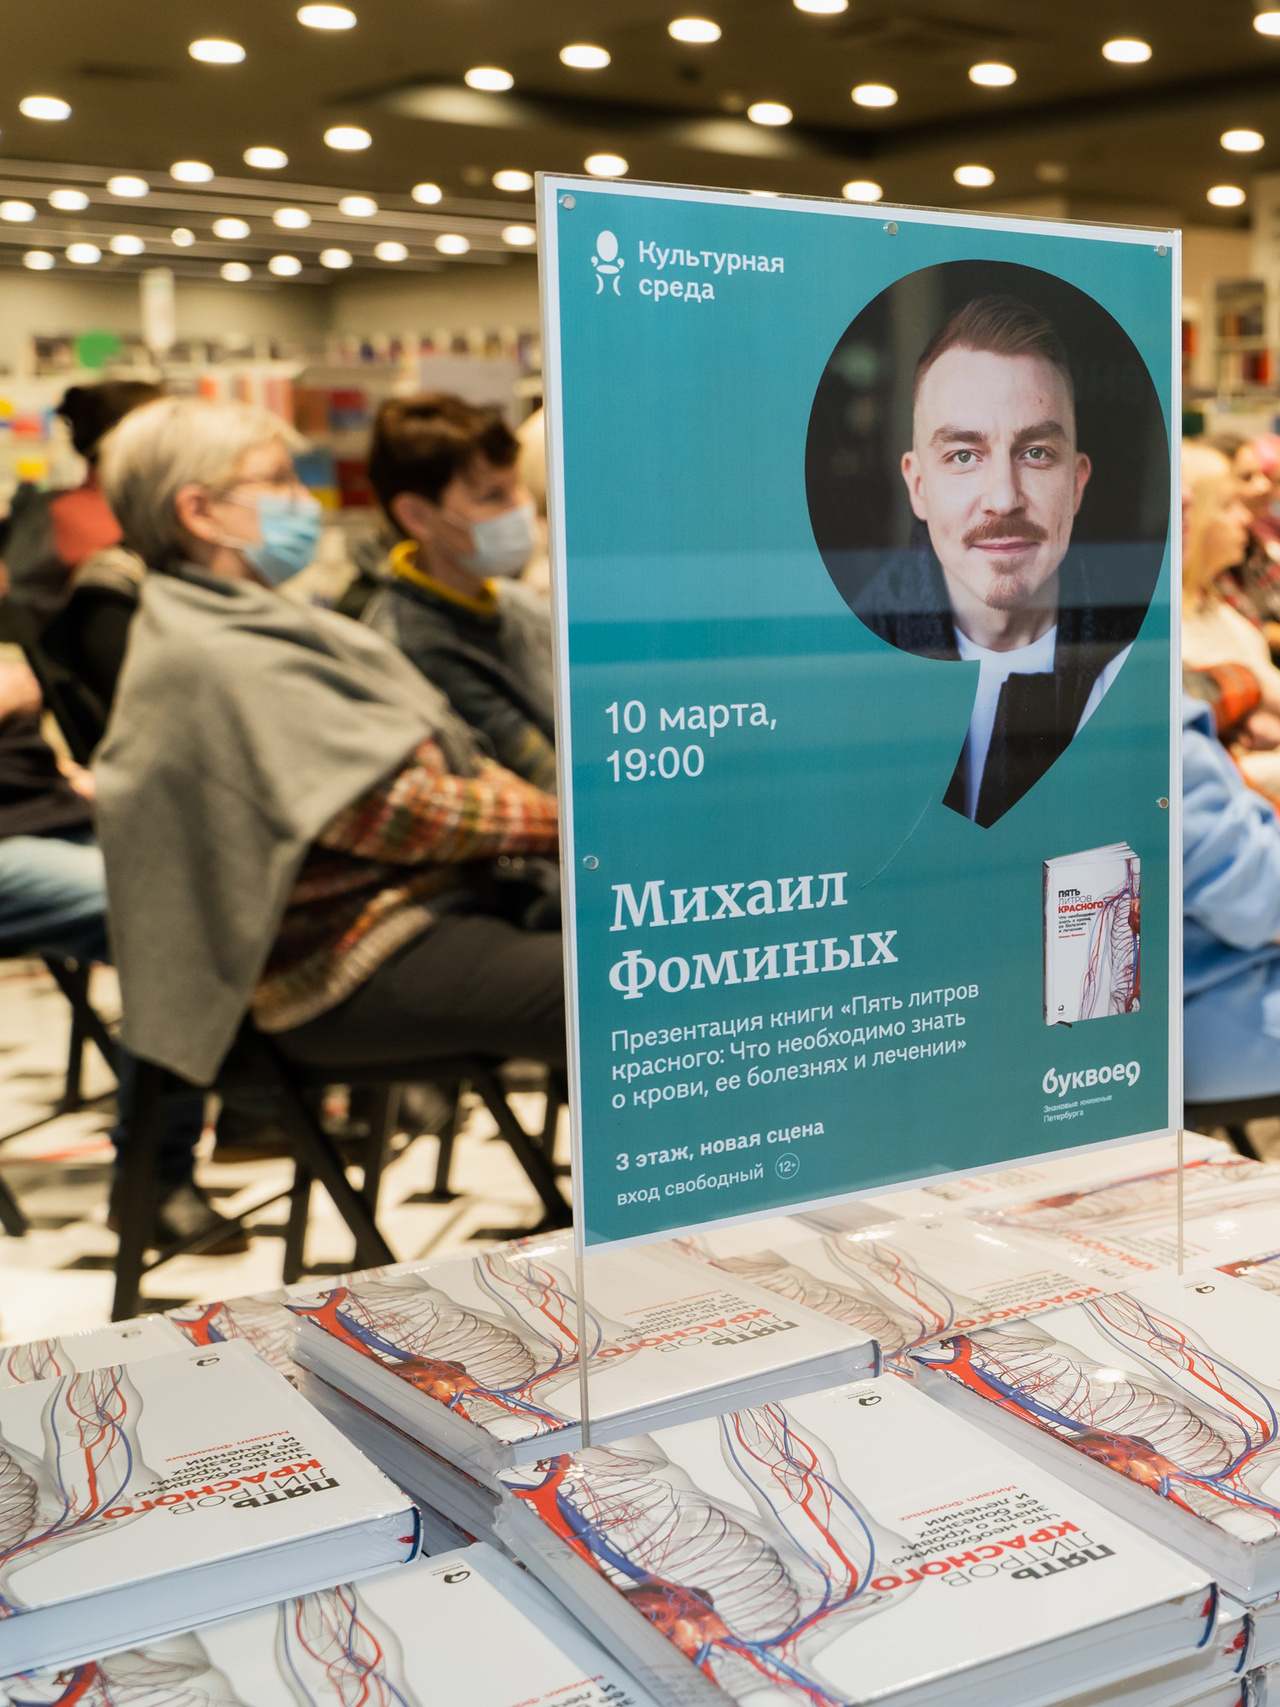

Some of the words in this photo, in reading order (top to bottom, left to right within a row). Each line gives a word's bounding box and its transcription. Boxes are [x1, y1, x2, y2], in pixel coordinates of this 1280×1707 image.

[638, 240, 784, 276] Культурная
[638, 278, 715, 303] среда
[605, 700, 646, 734] 10
[660, 701, 777, 738] марта,
[606, 745, 705, 782] 19:00
[609, 871, 848, 931] Михаил
[1058, 888, 1081, 898] ПЯТЬ
[1058, 894, 1092, 906] ЛИТРОВ
[1058, 901, 1104, 914] КРАСНОГО
[608, 930, 898, 1000] Фоминых
[612, 1015, 763, 1054] Презентация
[771, 1005, 833, 1028] книги
[841, 995, 903, 1016] «Пять
[908, 984, 979, 1007] литров
[612, 1049, 725, 1083] красного:
[730, 1041, 770, 1060] Что
[778, 1021, 906, 1055] необходимо
[911, 1012, 966, 1034] знать
[611, 1093, 626, 1109] о
[633, 1080, 709, 1109] крови,
[716, 1074, 741, 1092] ее
[747, 1056, 848, 1087] болезнях
[854, 1054, 866, 1069] и
[872, 1039, 967, 1067] лечении»
[1042, 1061, 1140, 1098] буквоед
[1043, 1101, 1078, 1113] Знаковые
[1043, 1109, 1084, 1123] Петербурга
[616, 1153, 629, 1171] 3
[635, 1145, 694, 1168] этаж,
[700, 1132, 761, 1156] новая
[766, 1121, 825, 1143] сцена
[617, 1187, 660, 1206] вход
[665, 1162, 764, 1197] свободный
[778, 1161, 797, 1173] 12+
[952, 1287, 1103, 1329] КРАСНОГО
[597, 1308, 772, 1358] КРАСНОГО
[655, 1314, 783, 1352] ЛИТРОВ
[711, 1320, 800, 1346] ПЯТЬ
[237, 1430, 290, 1444] Михаил
[165, 1444, 233, 1462] Фоминых
[171, 1449, 270, 1476] болезнях
[186, 1441, 274, 1465] лечении
[246, 1446, 306, 1462] знать
[274, 1453, 311, 1463] Что
[102, 1459, 323, 1519] КРАСНОГО
[134, 1462, 267, 1498] необходимо
[151, 1466, 222, 1486] крови,
[168, 1468, 327, 1515] ЛИТРОВ
[233, 1477, 340, 1508] ПЯТЬ
[966, 1485, 1018, 1502] Михаил
[899, 1501, 963, 1522] Фоминых
[917, 1508, 1010, 1539] болезнях
[925, 1498, 1010, 1526] лечении
[995, 1506, 1049, 1523] знать
[1023, 1513, 1060, 1526] Что
[892, 1524, 1017, 1565] необходимо
[902, 1528, 970, 1550] крови,
[871, 1521, 1081, 1590] КРАСНОГО
[942, 1532, 1095, 1586] ЛИТРОВ
[1011, 1544, 1116, 1579] ПЯТЬ
